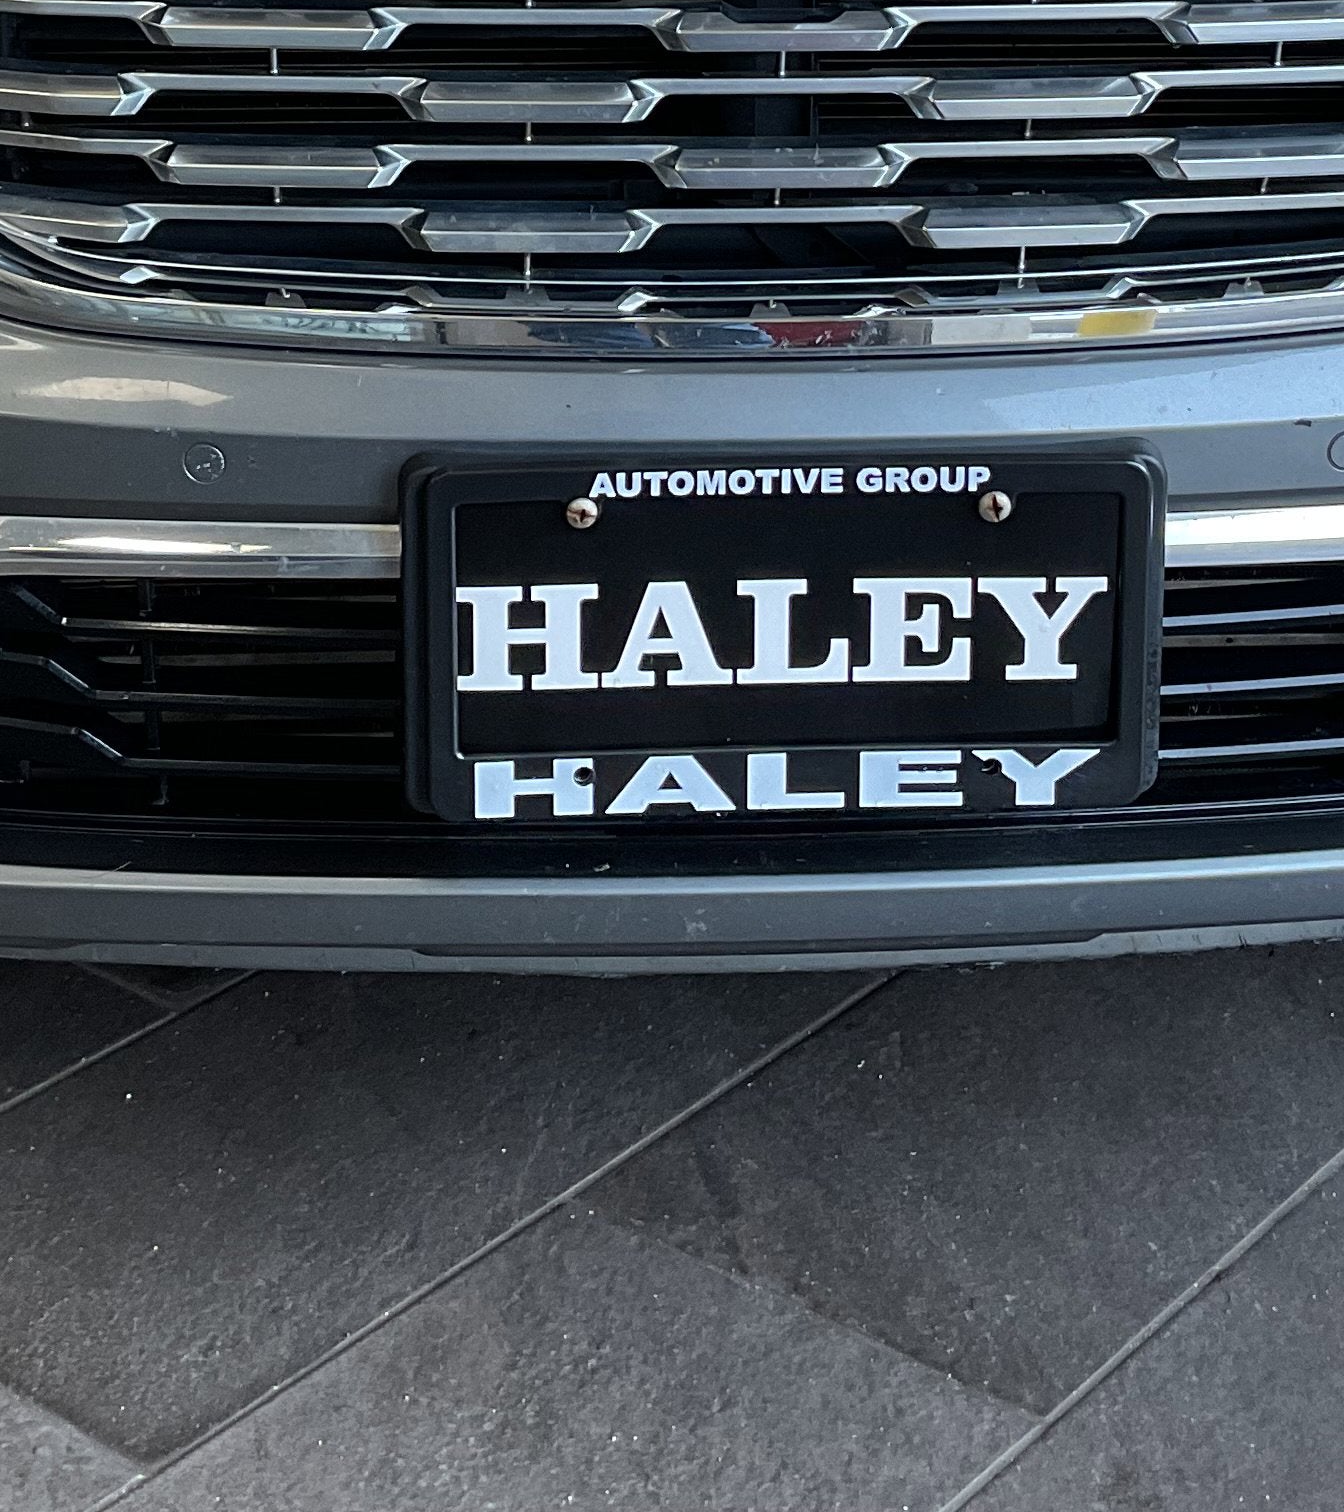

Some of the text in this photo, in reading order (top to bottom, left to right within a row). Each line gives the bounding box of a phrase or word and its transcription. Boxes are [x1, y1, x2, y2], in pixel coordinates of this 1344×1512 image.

[588, 466, 992, 498] AUTOMOTIVE GROUP
[455, 576, 1109, 692] HALEY
[474, 748, 1102, 820] HALEY
